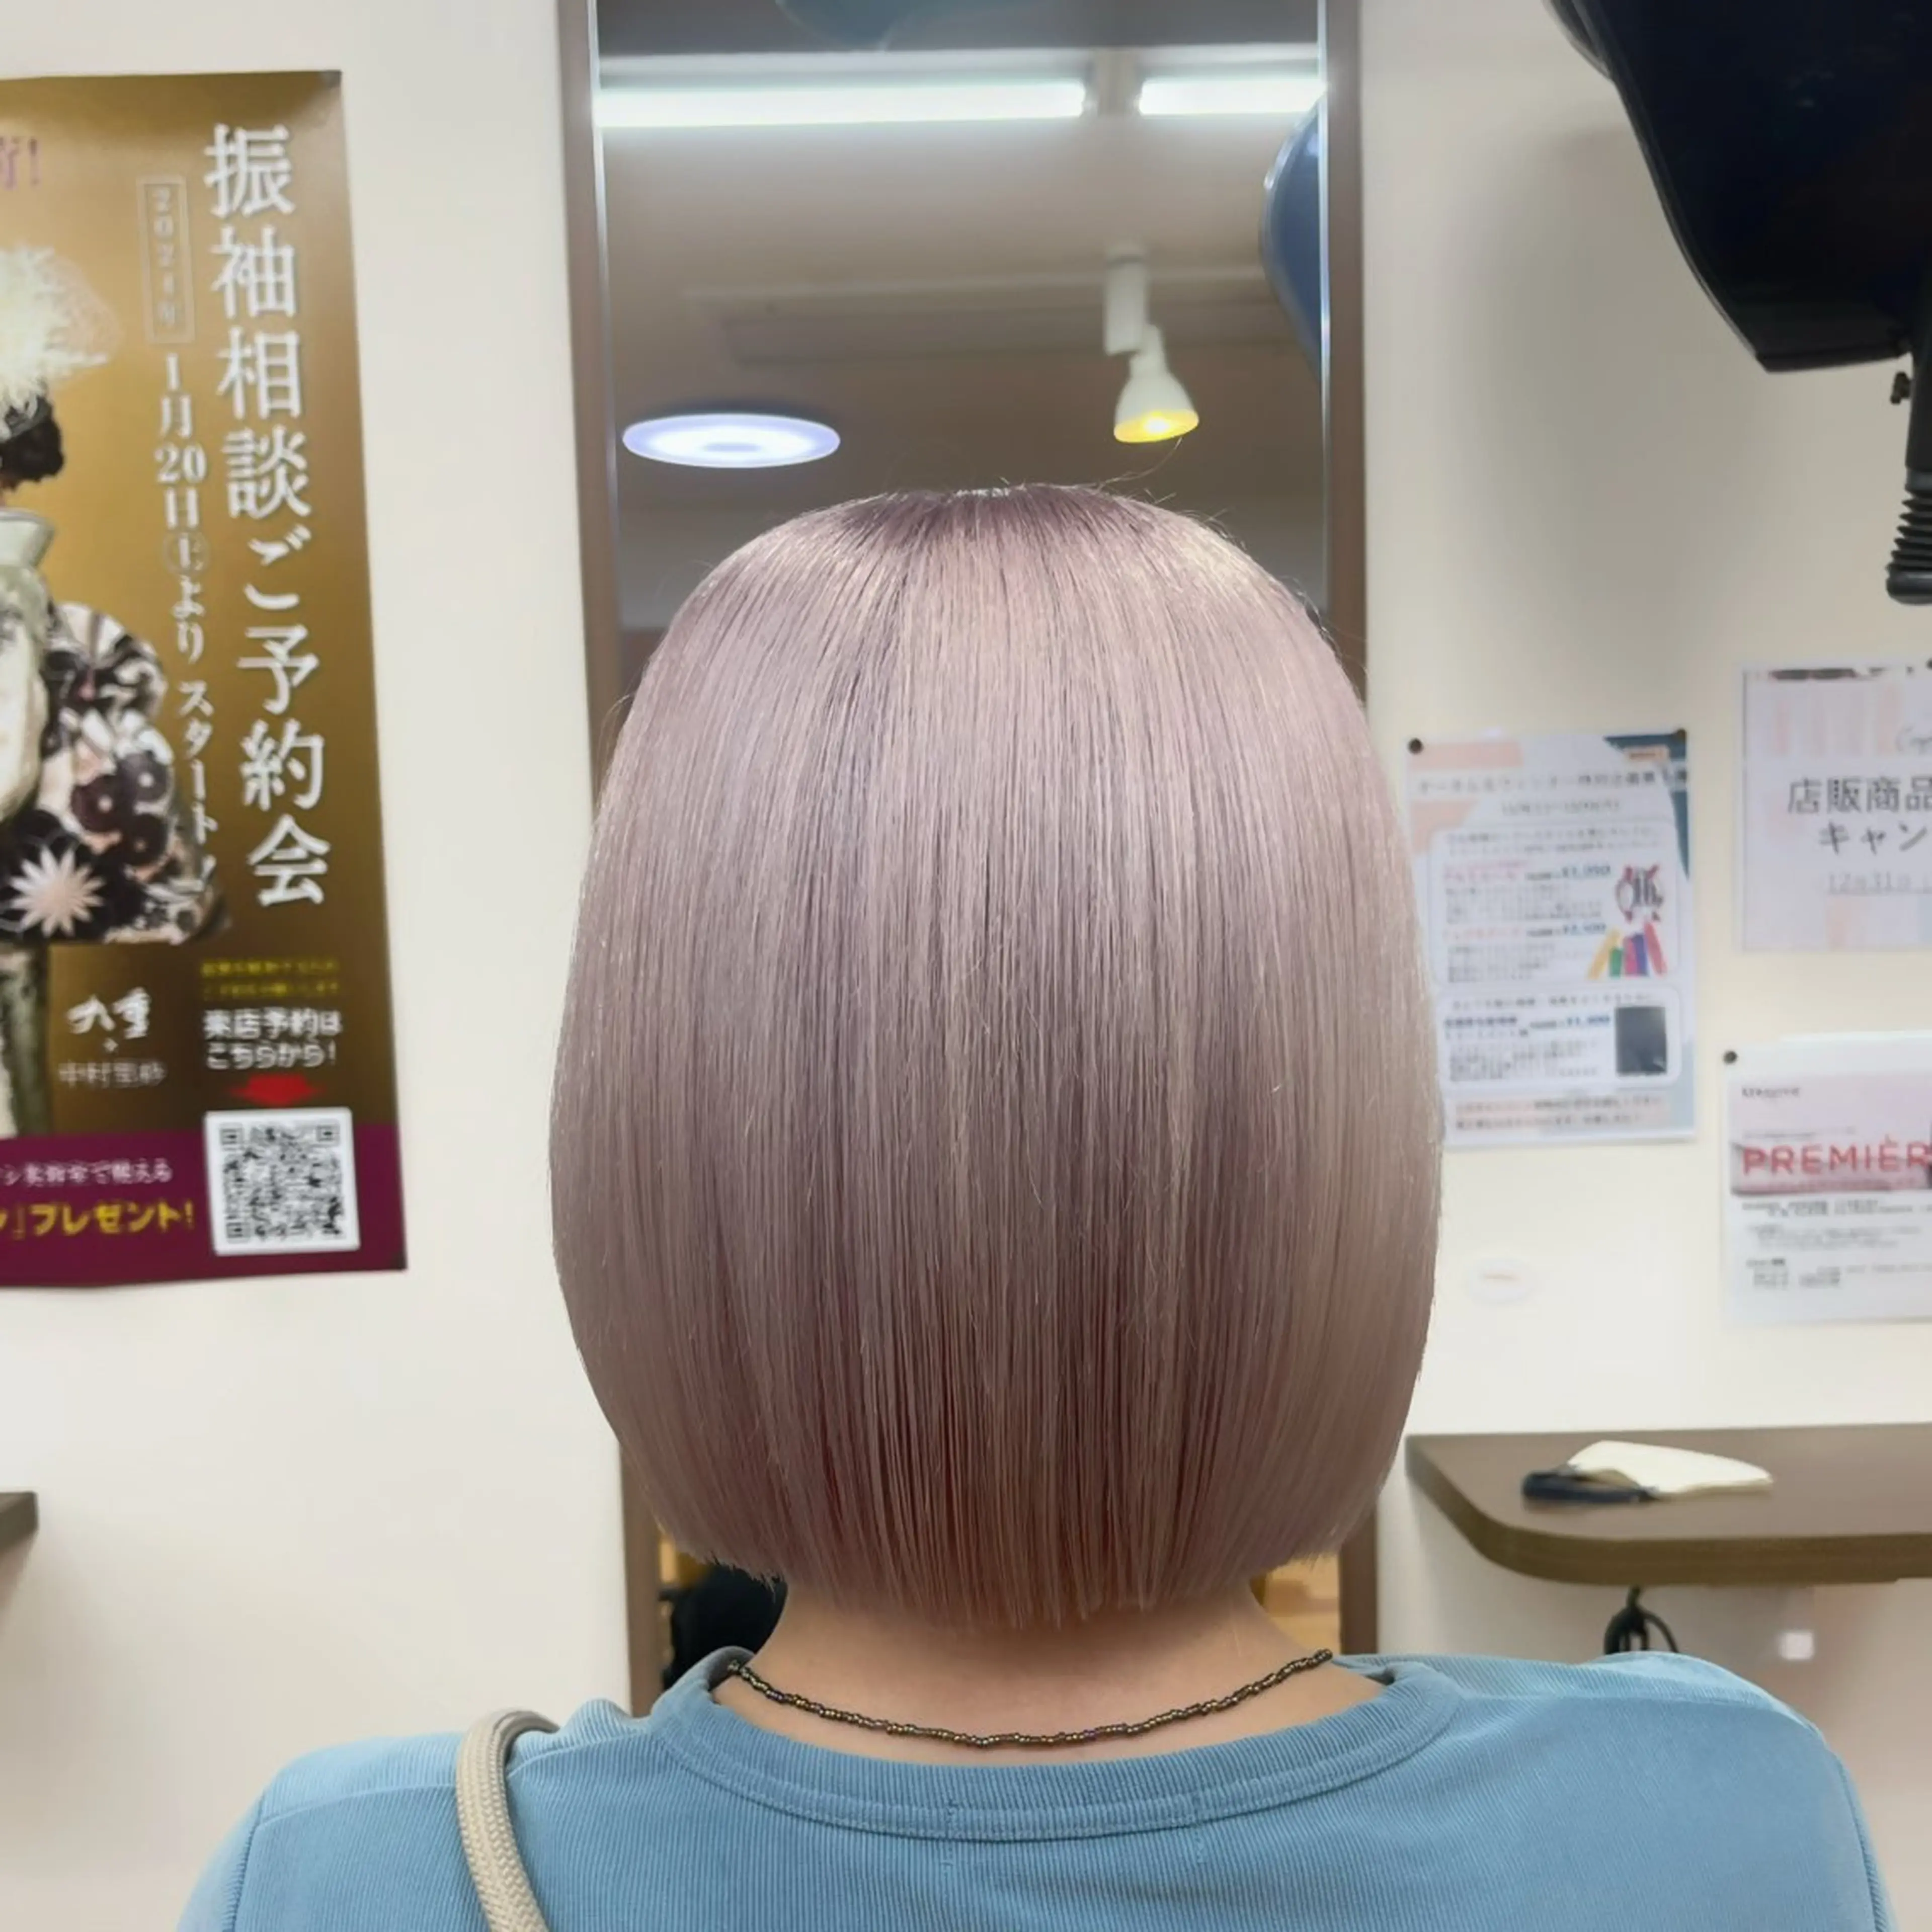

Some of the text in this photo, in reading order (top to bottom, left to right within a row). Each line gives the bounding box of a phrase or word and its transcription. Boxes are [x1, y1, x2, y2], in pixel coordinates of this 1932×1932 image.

[203, 123, 331, 907] 振袖相談ご予約会
[1788, 775, 1932, 814] 店販商品
[1817, 821, 1928, 854] キャン
[203, 1007, 342, 1040] 来店予約は
[206, 1040, 336, 1070] こちらから!
